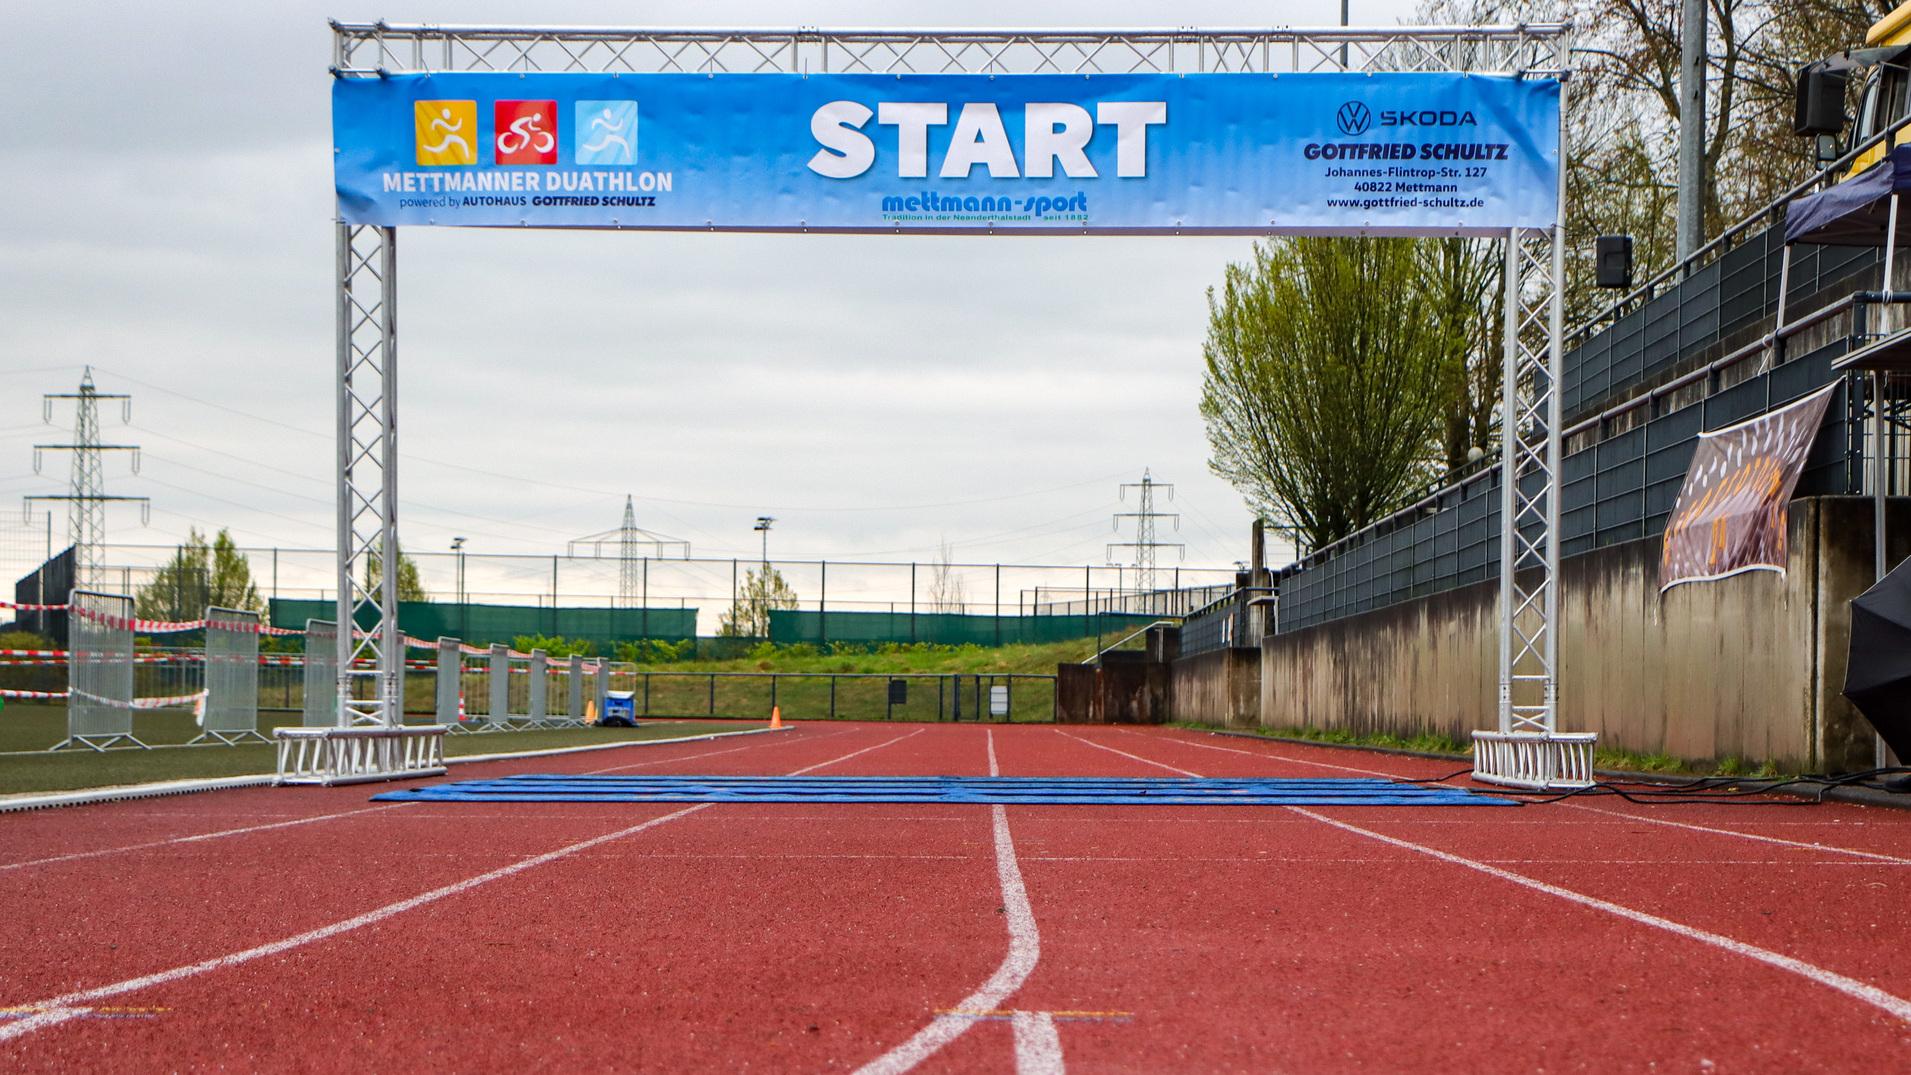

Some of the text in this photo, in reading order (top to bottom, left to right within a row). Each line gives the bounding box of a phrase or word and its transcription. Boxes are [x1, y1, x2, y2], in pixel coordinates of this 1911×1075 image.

[1381, 111, 1478, 126] SKODA
[806, 100, 1167, 179] START
[1304, 143, 1510, 160] GOTTFRIED SCHULTZ
[1325, 167, 1488, 179] Johannes-Flintrop-Str. 127
[383, 172, 673, 192] METTMANNER DUATHLON
[1354, 182, 1458, 193] 40822 Mettmann
[400, 196, 656, 208] powered by AUTOHAUS GOTTFRIED SCHULTZ
[881, 191, 1088, 216] mettmann-sport
[1327, 197, 1484, 209] www.gottfried-schultz.de
[882, 213, 923, 221] Tradition
[924, 213, 934, 221] in
[936, 213, 951, 221] der
[953, 213, 1031, 221] Neanderthalstadt
